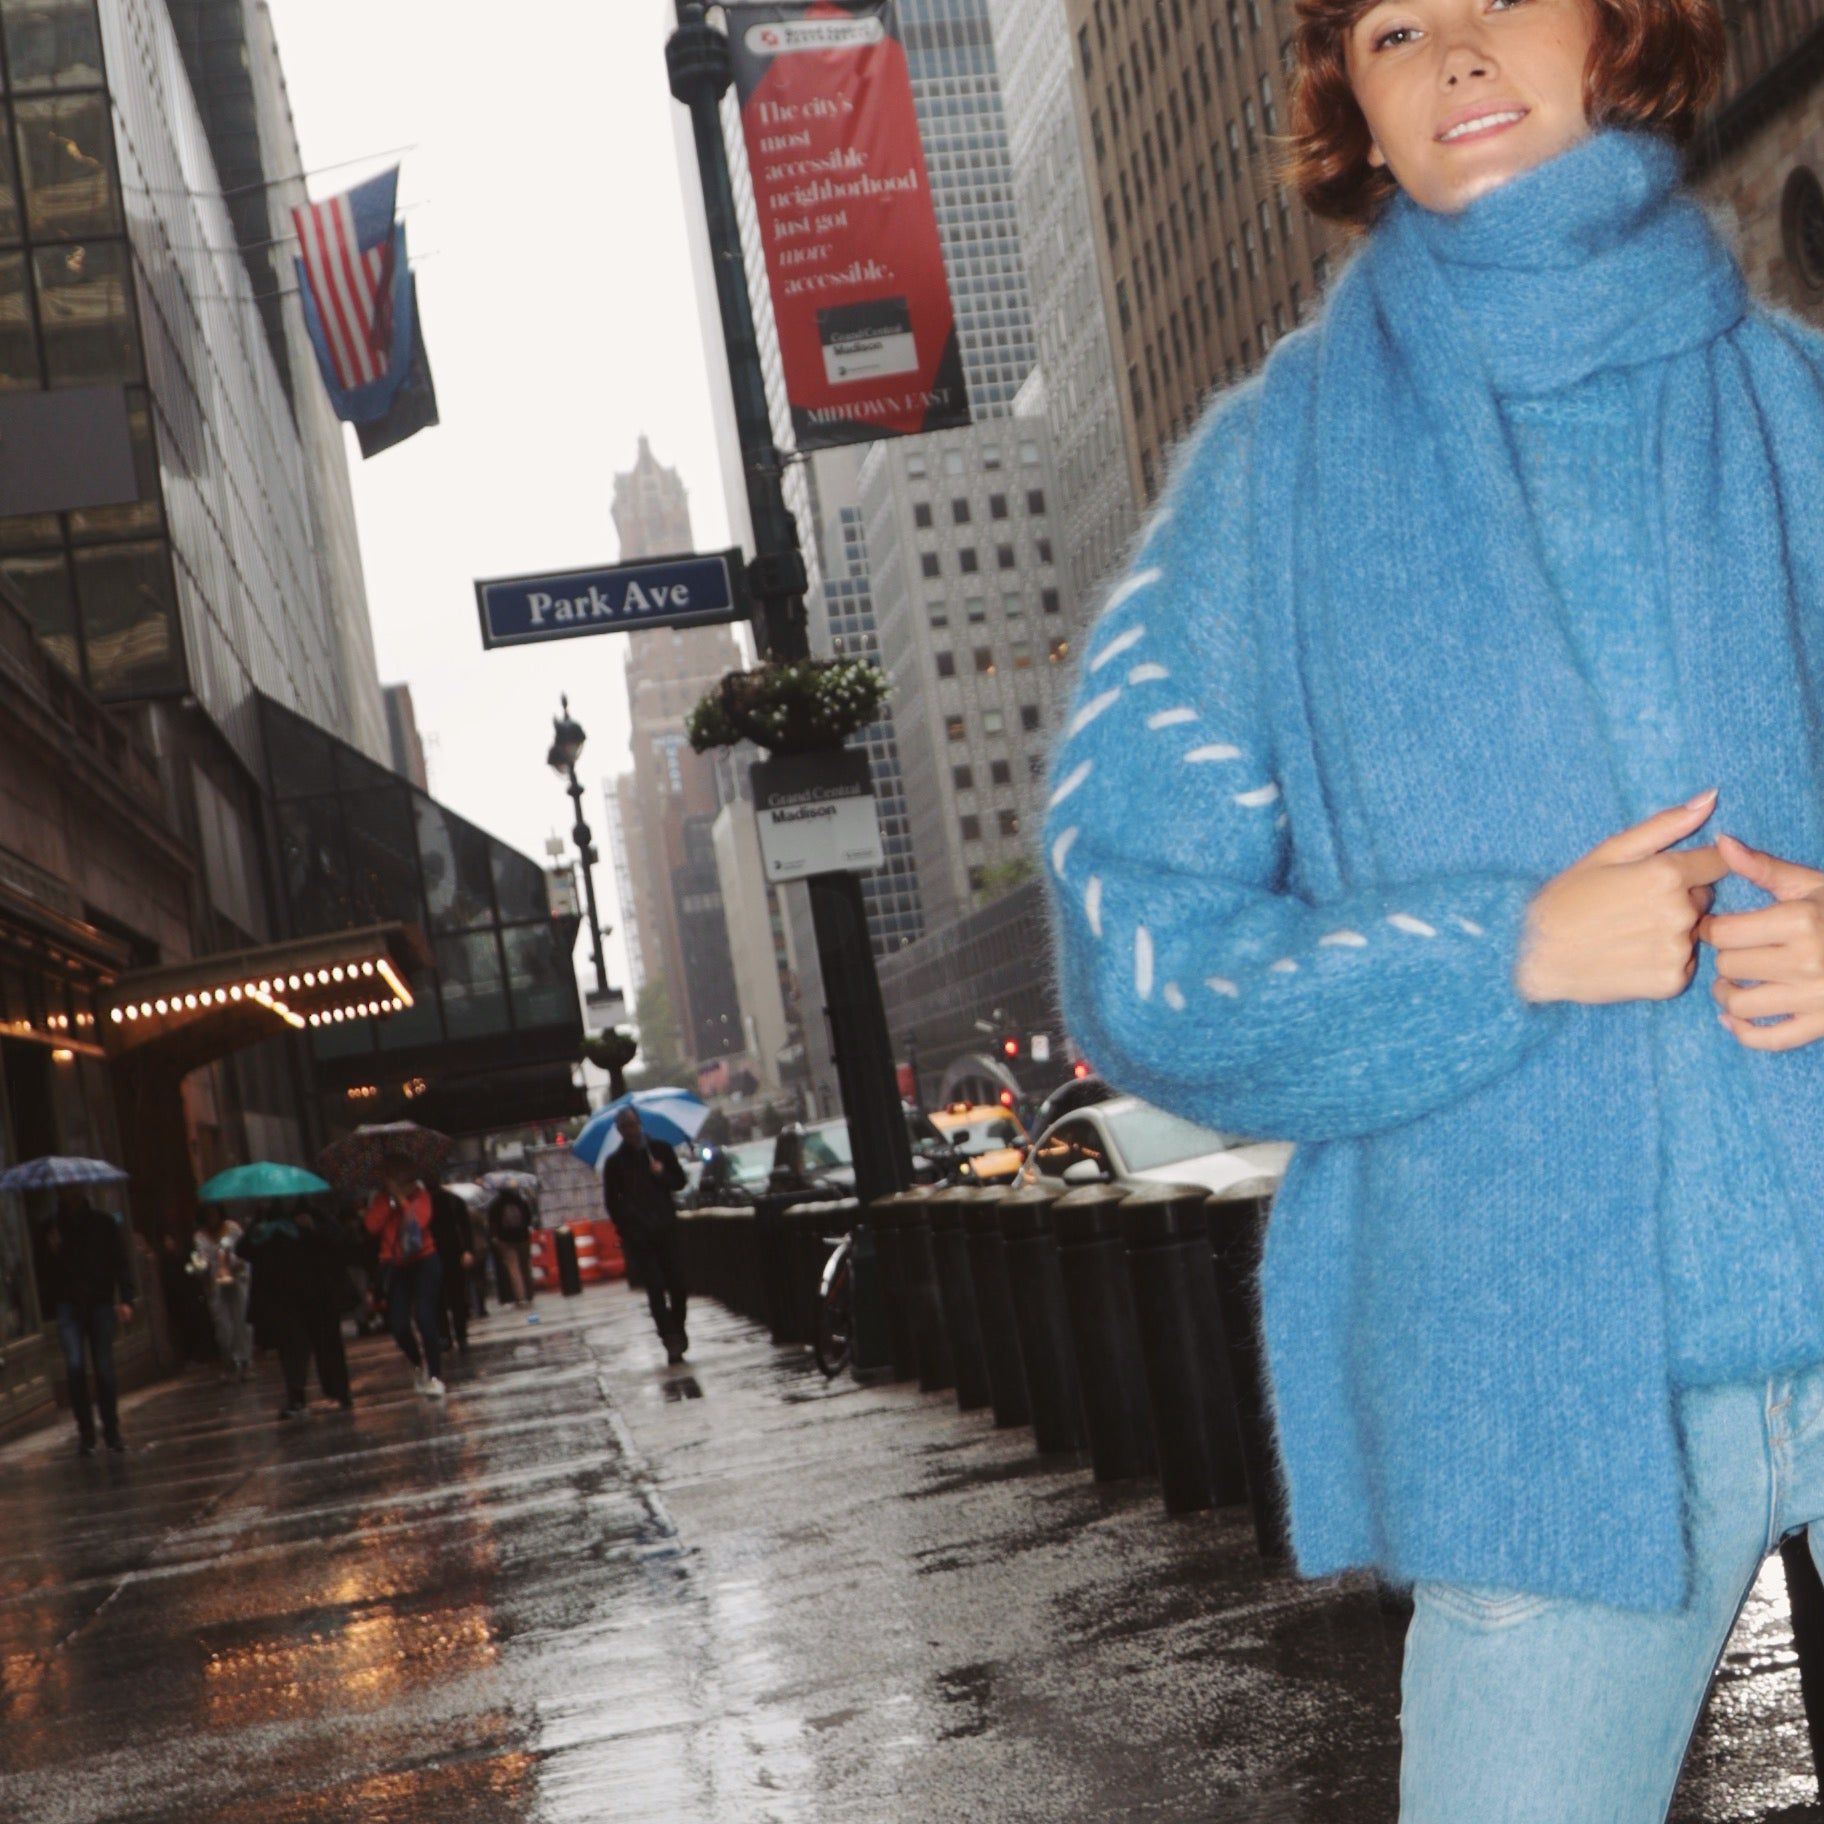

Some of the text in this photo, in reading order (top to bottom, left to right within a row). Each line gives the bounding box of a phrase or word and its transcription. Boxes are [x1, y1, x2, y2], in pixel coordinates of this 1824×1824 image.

[758, 92, 854, 124] The city's
[760, 129, 811, 154] most
[765, 147, 868, 181] accessible
[769, 168, 919, 210] neighborhood
[774, 210, 849, 241] just got
[779, 243, 833, 267] more
[784, 259, 895, 295] accessible.
[807, 387, 950, 424] MIDTOWN EAST
[527, 581, 690, 625] Park Ave
[768, 782, 861, 806] Grand Central
[771, 805, 837, 824] Madison
